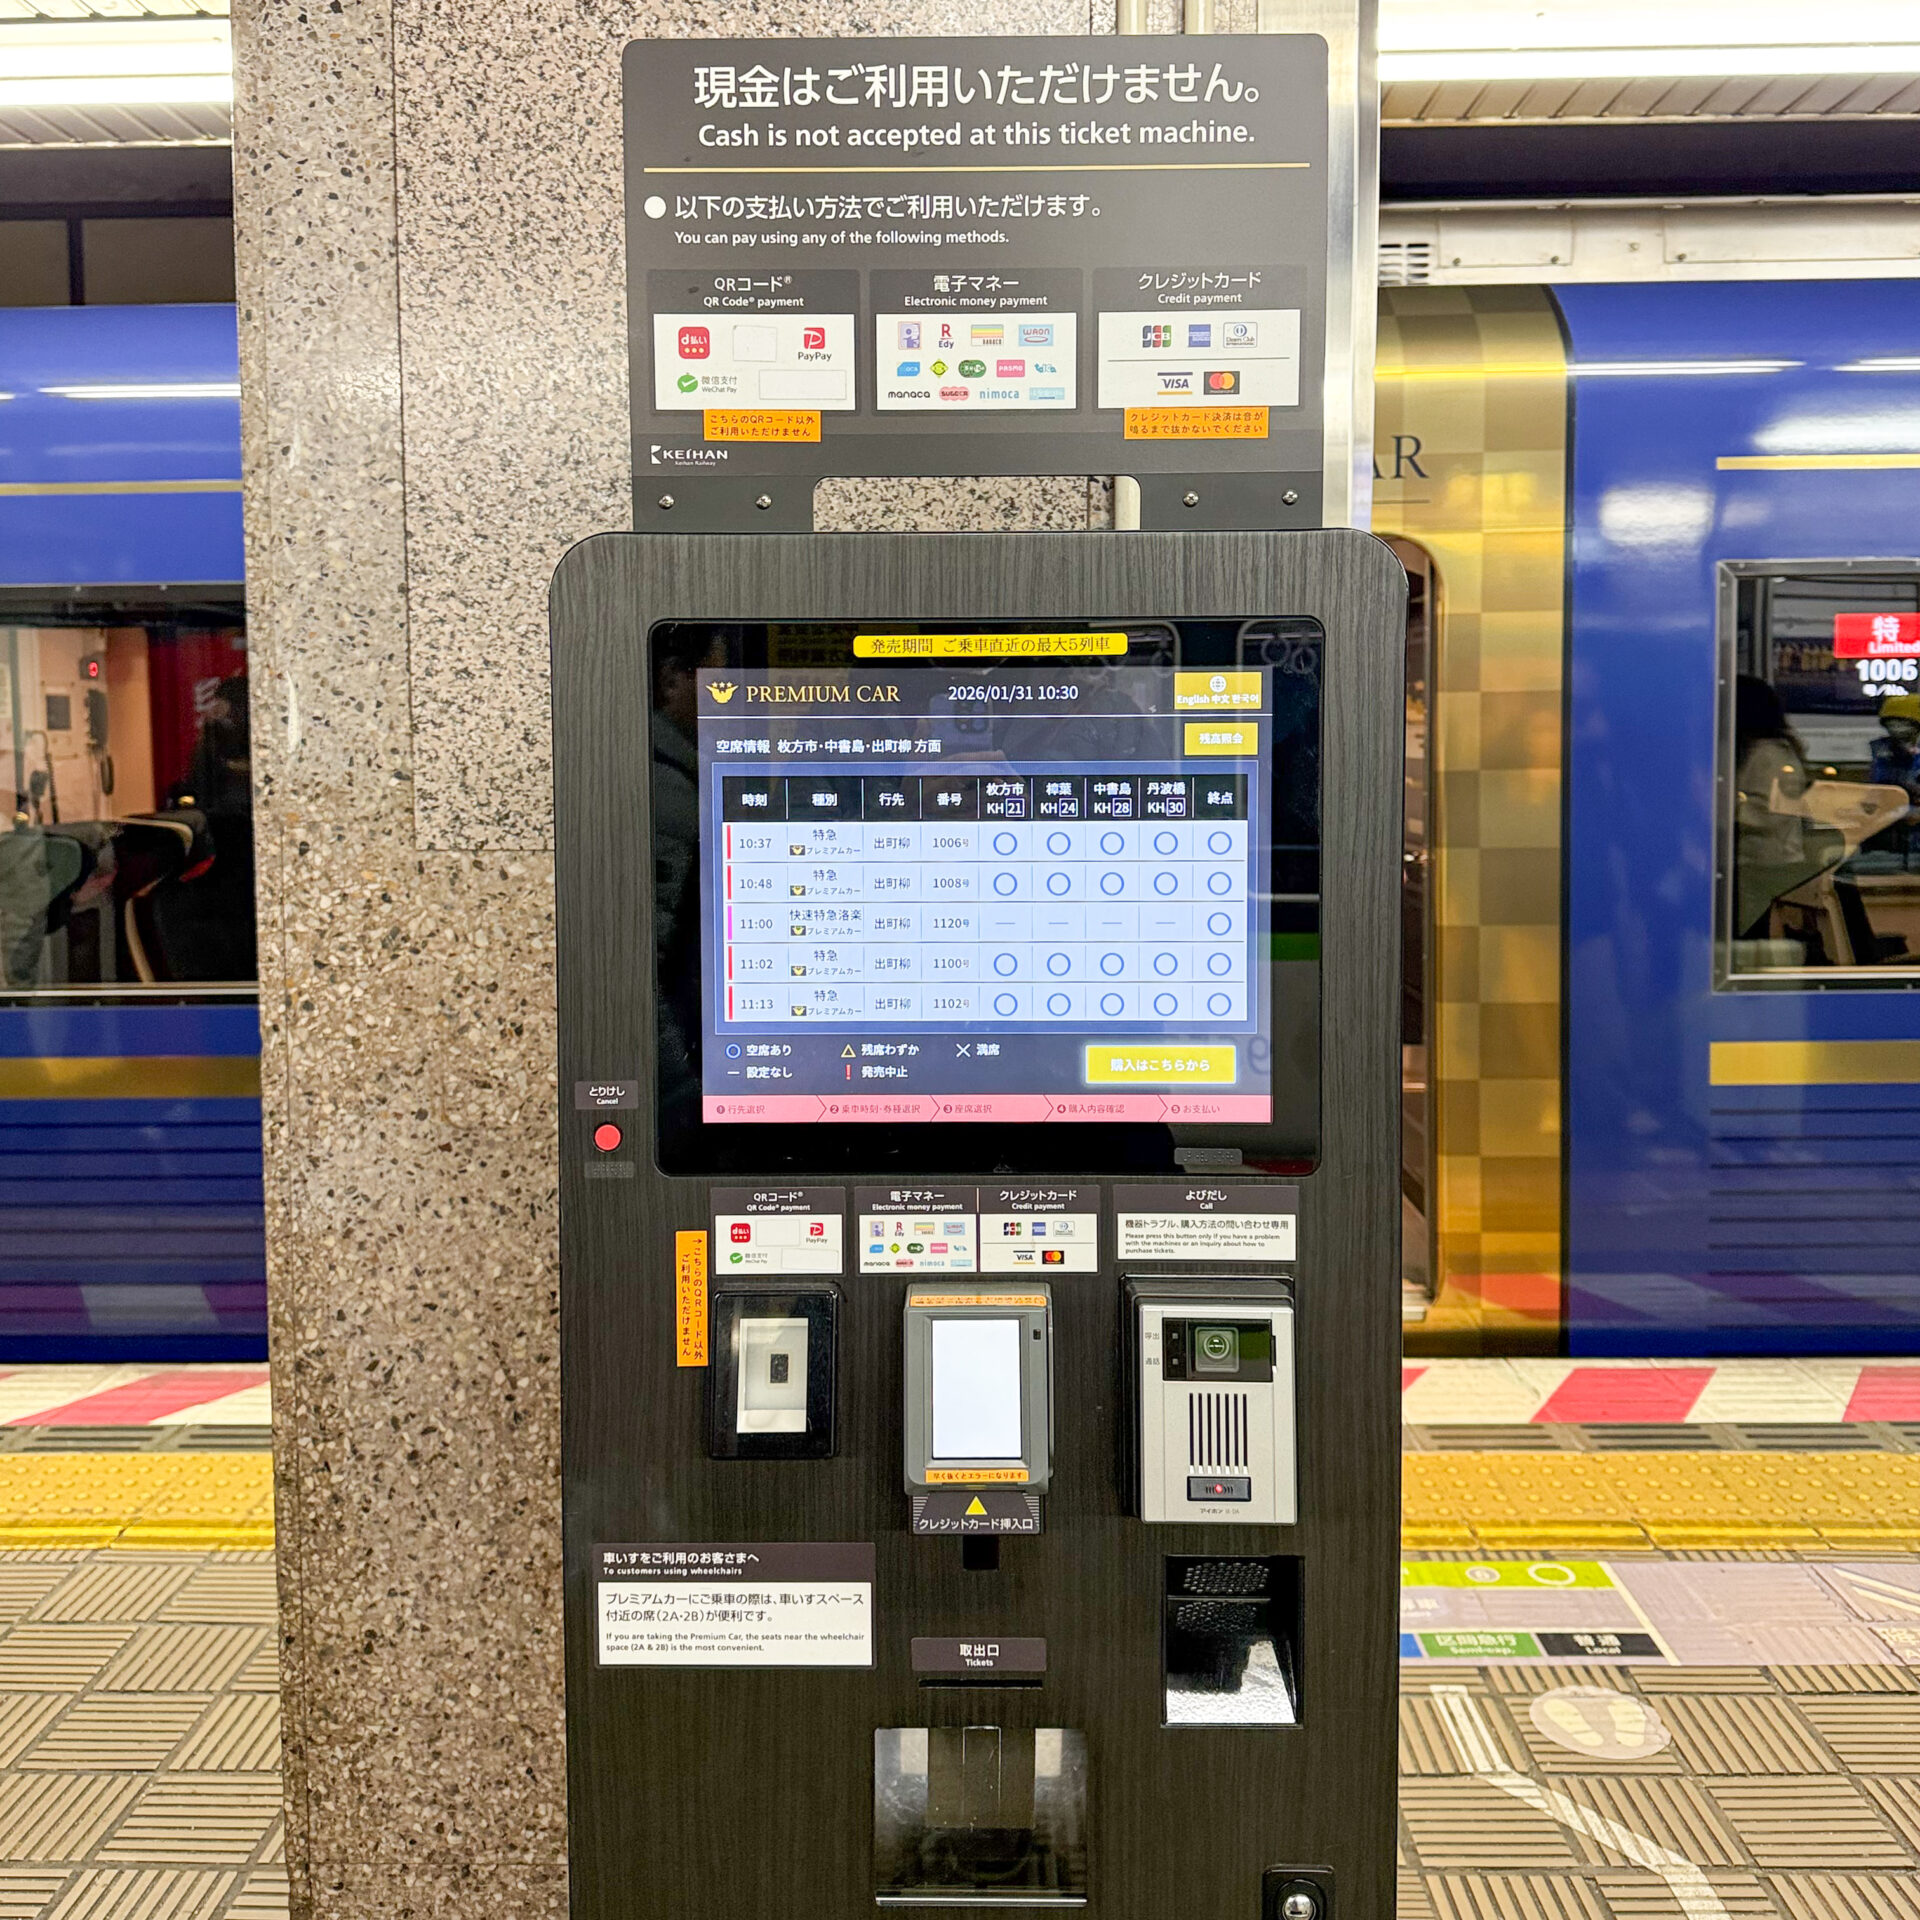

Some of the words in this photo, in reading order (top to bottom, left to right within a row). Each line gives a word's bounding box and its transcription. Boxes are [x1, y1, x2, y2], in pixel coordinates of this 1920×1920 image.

[693, 63, 1261, 108] 現金はご利用いただけません。
[699, 123, 758, 148] Cash
[769, 121, 787, 148] is
[795, 126, 839, 148] not
[848, 125, 961, 152] accepted
[970, 125, 996, 145] at
[1003, 121, 1050, 145] this
[1059, 121, 1131, 144] ticket
[1140, 120, 1254, 143] machine.
[674, 194, 1103, 219] 以下の支払い方法でご利用いただけます。
[675, 231, 700, 244] You
[705, 234, 728, 244] can
[732, 234, 757, 247] pay
[761, 231, 798, 247] using
[802, 234, 827, 247] any
[831, 230, 846, 244] of
[849, 231, 872, 244] the
[876, 230, 941, 246] following
[946, 230, 1009, 243] methods.
[933, 275, 1020, 293] 電子マネー
[1138, 271, 1263, 290] クレジットカード
[703, 296, 719, 308] QR
[757, 298, 804, 308] payment
[905, 296, 956, 307] Electronic
[960, 298, 996, 308] money
[1000, 297, 1048, 308] payment
[1158, 293, 1190, 303] Credit
[1194, 294, 1242, 305] payment
[1143, 331, 1171, 342] JCB
[938, 340, 955, 350] Edy
[797, 352, 832, 362] PayPay
[702, 376, 738, 385] 微信支付
[1161, 379, 1190, 389] VISA
[888, 391, 931, 399] manaca
[980, 388, 1020, 400] nimoca
[710, 415, 816, 425] こちらのQRコード以外
[1130, 412, 1264, 422] クレジットカード決済は音が
[710, 426, 812, 437] ご利用いただけません
[871, 639, 933, 655] 発売期間
[944, 637, 1110, 654] ご乗車直近の最大5列車
[1855, 658, 1918, 682] 1006
[746, 686, 850, 702] PREMIUM
[857, 685, 900, 702] CAR
[948, 685, 1033, 703] 2026/01/31
[1038, 685, 1079, 700] 10:30
[716, 739, 771, 754] 空席情報
[914, 739, 942, 754] 方面
[741, 793, 768, 808] 時刻
[811, 793, 838, 808] 種別
[878, 793, 905, 807] 行先
[936, 792, 962, 807] 番号
[1207, 791, 1234, 806] 終点
[813, 829, 837, 841] 特急
[739, 838, 772, 849] 10:37
[873, 837, 911, 849] 出町柳
[806, 847, 862, 855] プレミアムカー
[813, 869, 837, 881] 特急
[739, 878, 772, 889] 10:48
[873, 877, 911, 889] 出町柳
[806, 887, 862, 895] プレミアムカー
[740, 918, 772, 929] 11:00
[874, 917, 912, 929] 出町柳
[806, 927, 862, 935] プレミアムカー
[814, 950, 838, 962] 特急
[740, 959, 773, 970] 11:02
[874, 958, 912, 970] 出町柳
[807, 968, 863, 976] プレミアムカー
[814, 990, 838, 1002] 特急
[740, 999, 773, 1010] 11:13
[874, 998, 912, 1010] 出町柳
[807, 1008, 863, 1016] プレミアムカー
[746, 1044, 792, 1057] 空席あり
[861, 1044, 920, 1056] 残席わずか
[1110, 1058, 1211, 1072] 購入はこちらから
[588, 1086, 626, 1097] とりけし
[1183, 1104, 1221, 1115] お支払い
[890, 1190, 945, 1202] 電子マネー
[999, 1189, 1078, 1201] クレジットカード
[1185, 1189, 1228, 1201] よびだし
[872, 1203, 905, 1211] Electronic
[1199, 1202, 1214, 1210] Call
[681, 1253, 691, 1357] ご利用いただけません
[692, 1247, 704, 1360] こちらのQRコード以外
[918, 1517, 1034, 1531] クレジットカード挿入口
[603, 1552, 760, 1565] 車いすをご利用のお客さまへ
[603, 1567, 614, 1575] To
[664, 1567, 687, 1576] using
[690, 1567, 742, 1575] wheelchairs
[605, 1592, 865, 1606] プレミアムカーにご乗車の際は、車いすスペース
[606, 1632, 612, 1640] If
[614, 1634, 630, 1642] you
[646, 1633, 673, 1642] taking
[728, 1633, 743, 1641] Car,
[959, 1643, 1000, 1657] 取出口
[964, 1658, 994, 1667] Tickets
